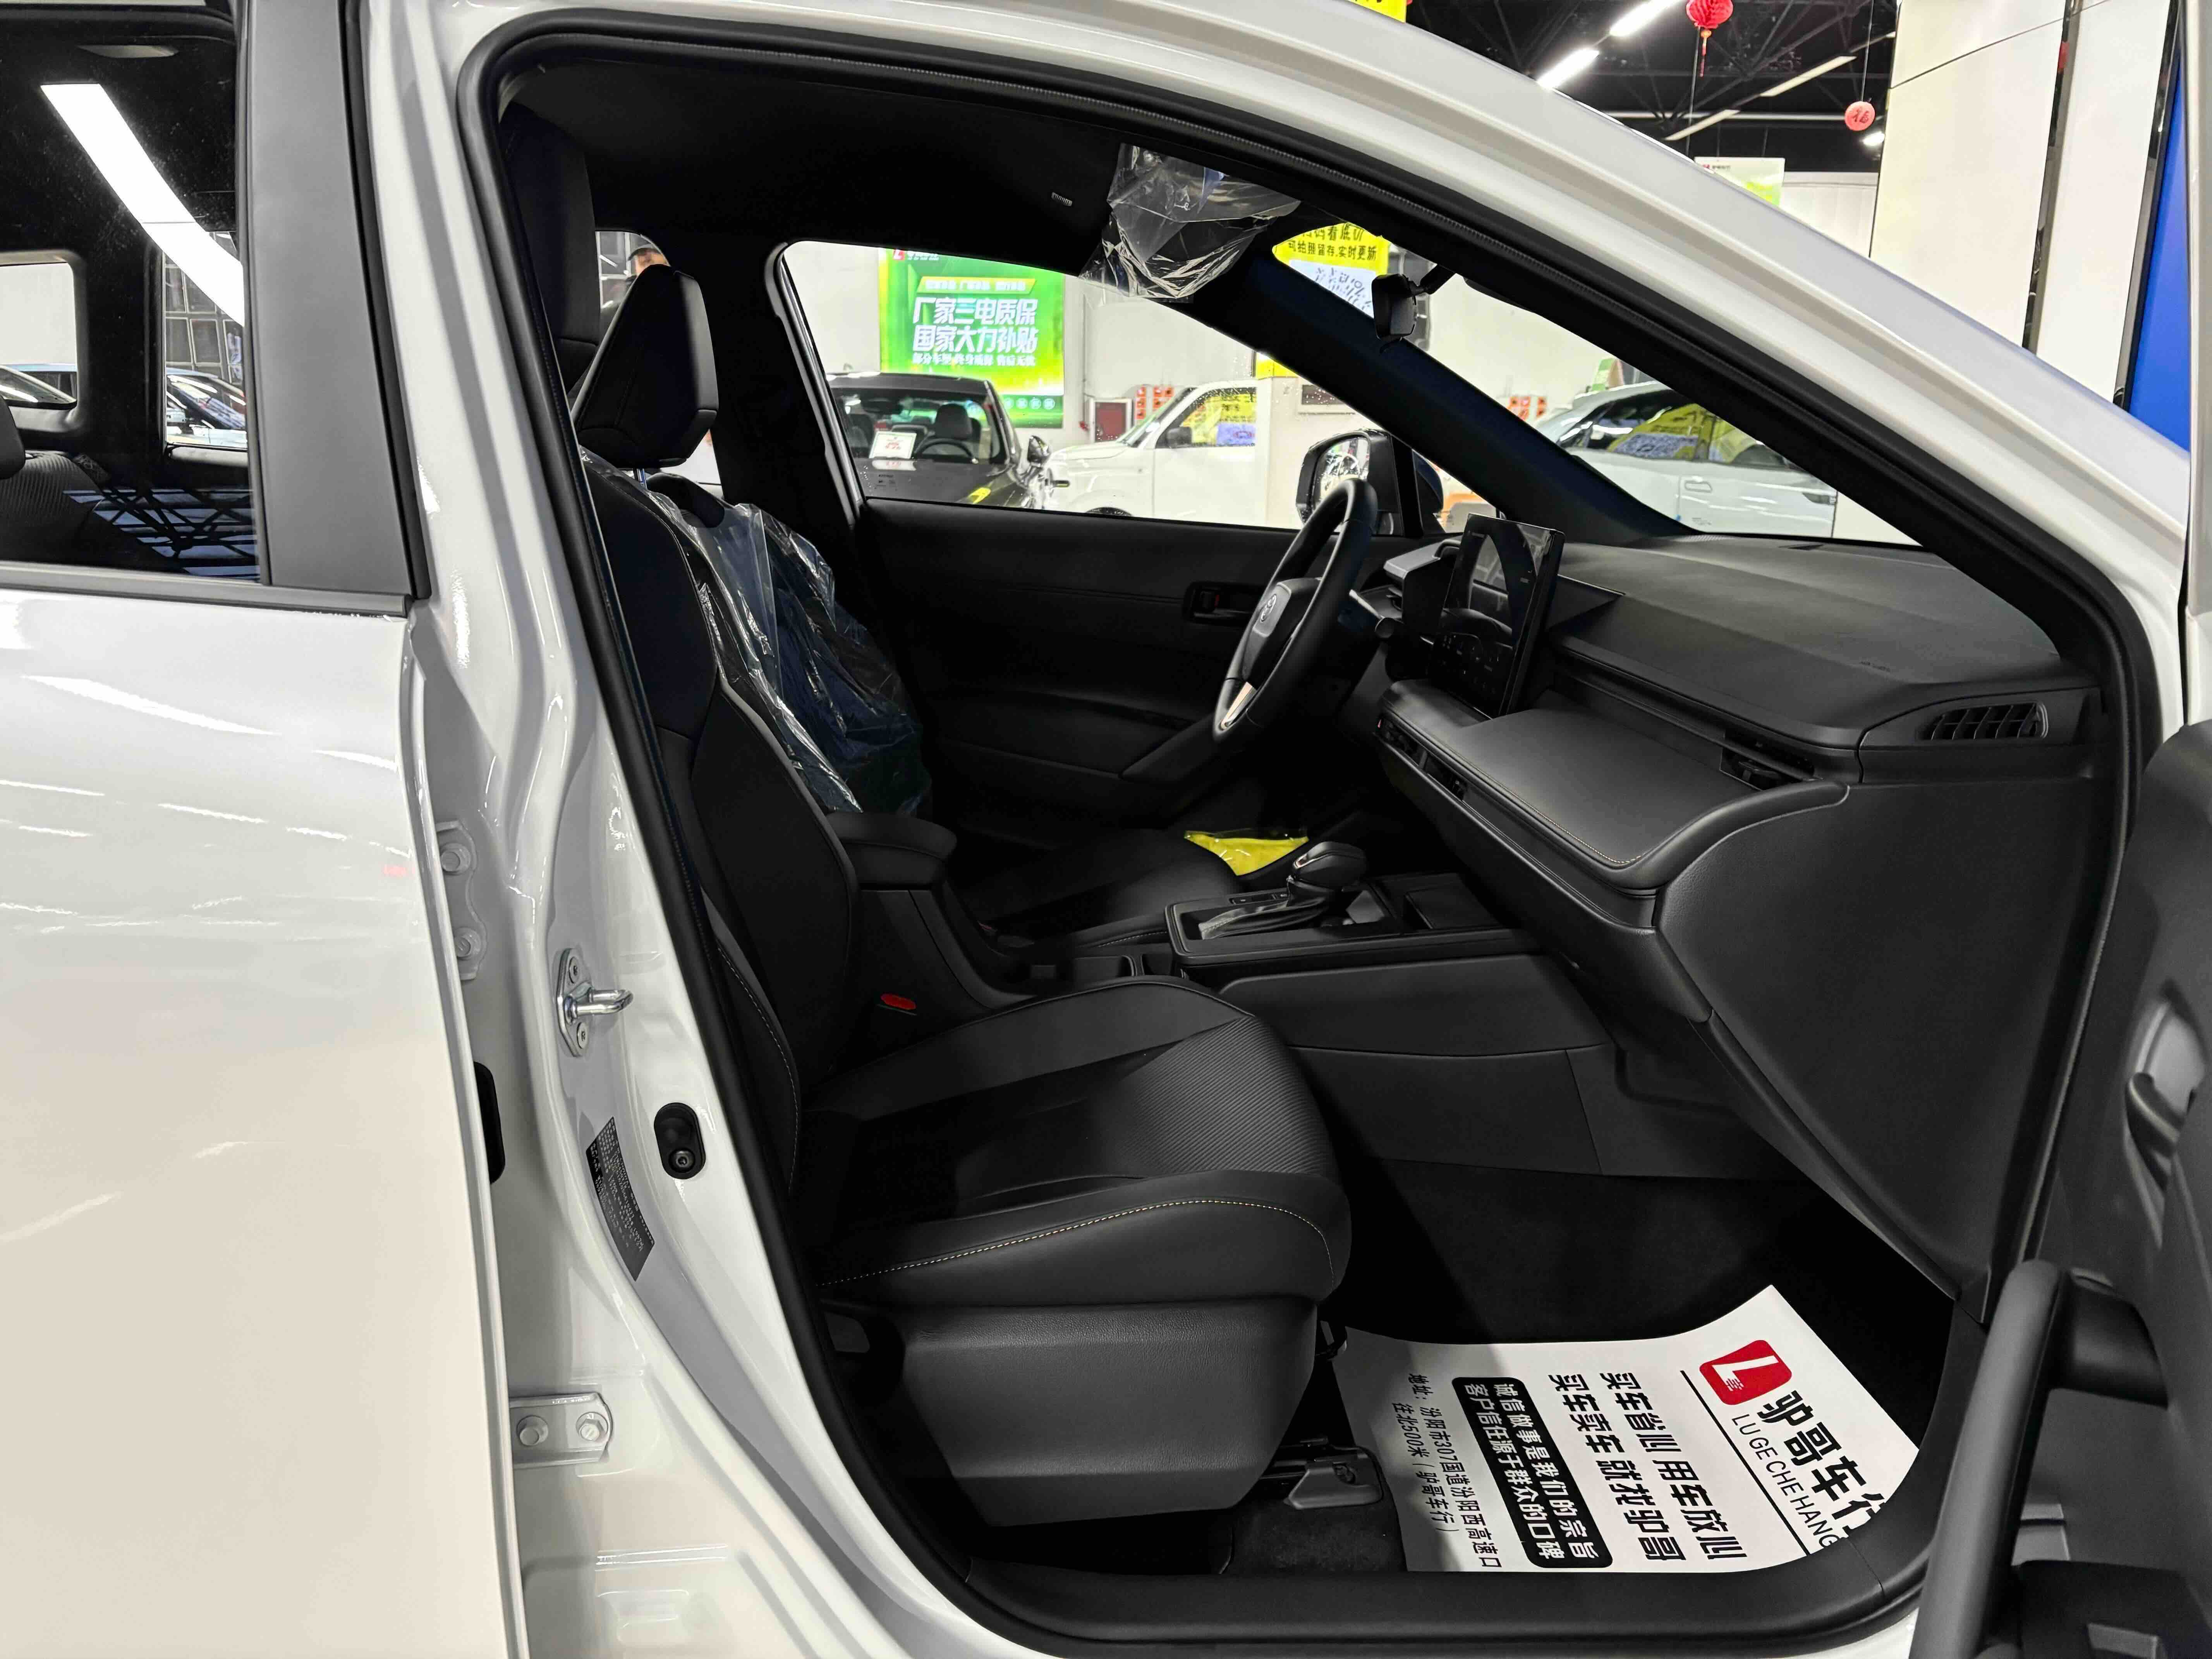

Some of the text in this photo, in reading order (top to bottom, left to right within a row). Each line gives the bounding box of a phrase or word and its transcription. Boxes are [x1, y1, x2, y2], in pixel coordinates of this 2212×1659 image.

[912, 325, 1039, 354] 国家大力补贴
[913, 297, 1039, 325] 厂家三电质保
[1464, 1384, 1565, 1559] 客户信任源于群众的口碑
[1493, 1383, 1599, 1559] 诚信做事是我们的宗旨
[1548, 1374, 1687, 1561] 买车卖车 就找驴哥
[1599, 1372, 1748, 1560] 买车省心 用车放心
[1731, 1414, 1839, 1547] LU GE CHE HANG
